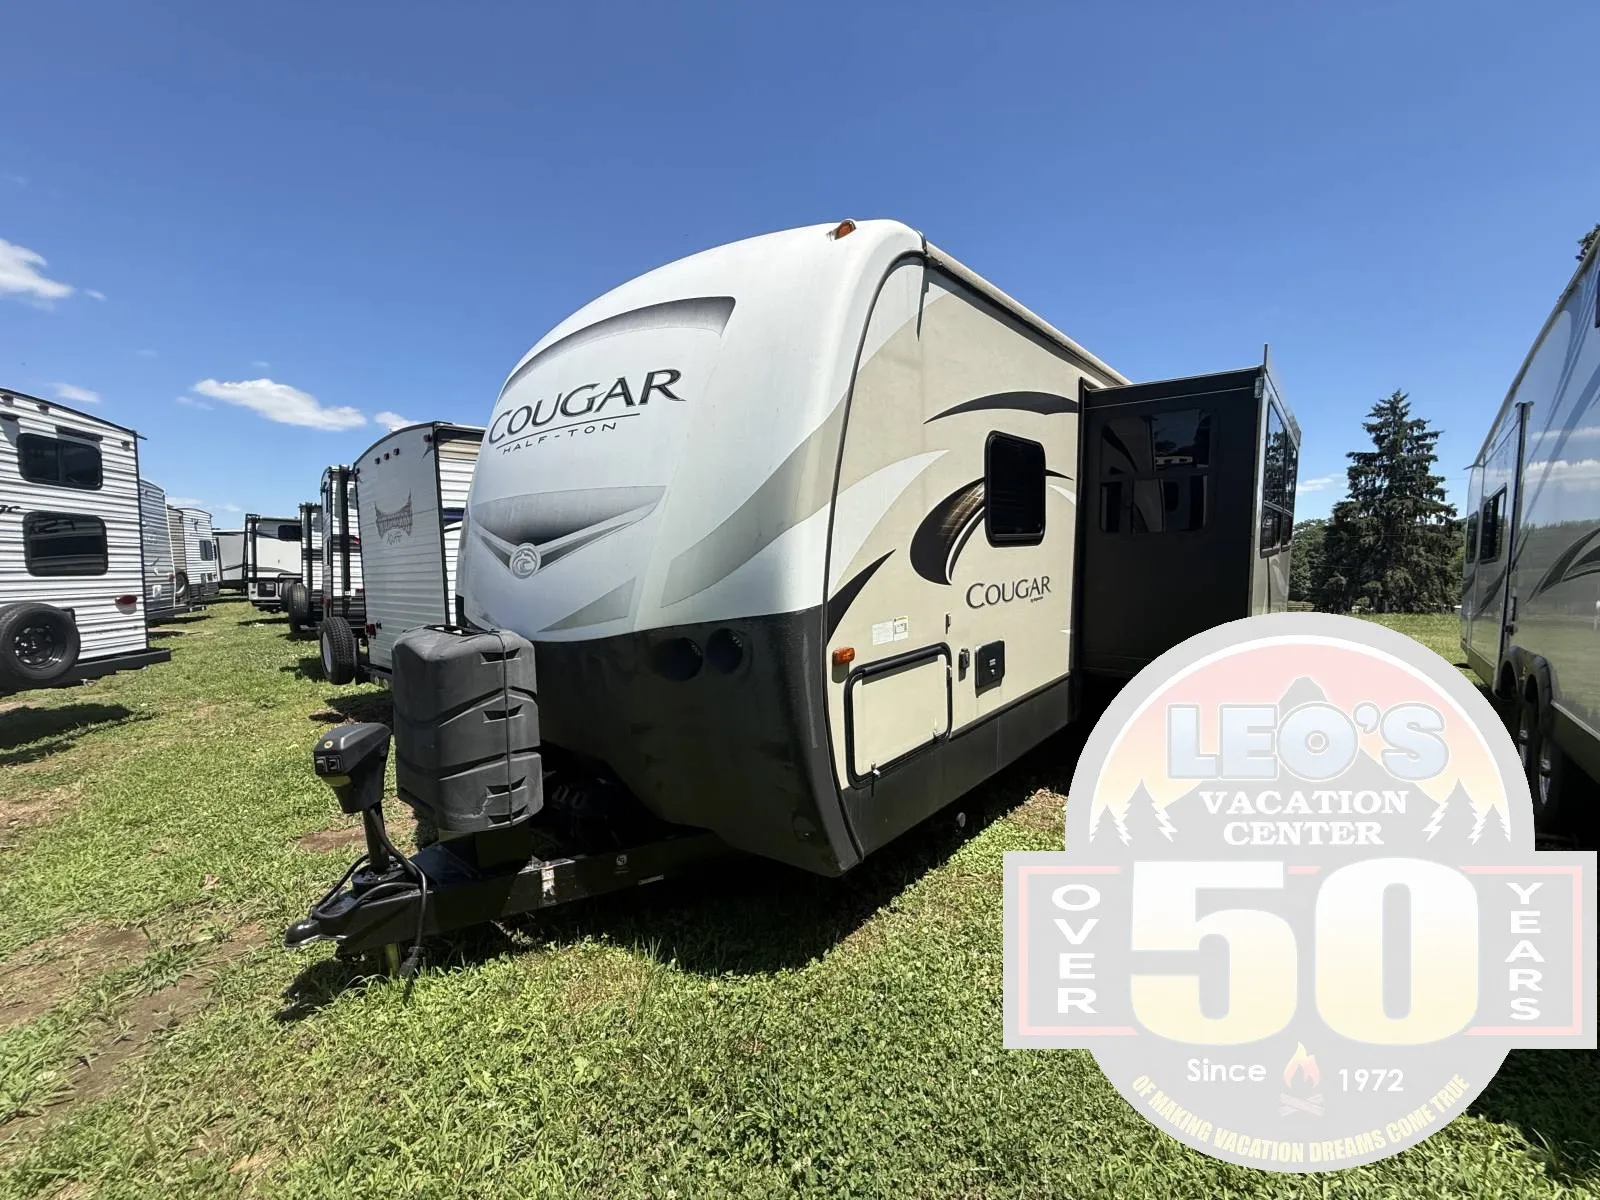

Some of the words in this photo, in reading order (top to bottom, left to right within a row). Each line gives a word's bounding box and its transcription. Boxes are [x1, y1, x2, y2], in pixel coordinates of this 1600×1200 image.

[488, 368, 687, 446] COUGAR
[502, 422, 617, 455] HALF-TON
[966, 576, 1051, 608] COUGAR
